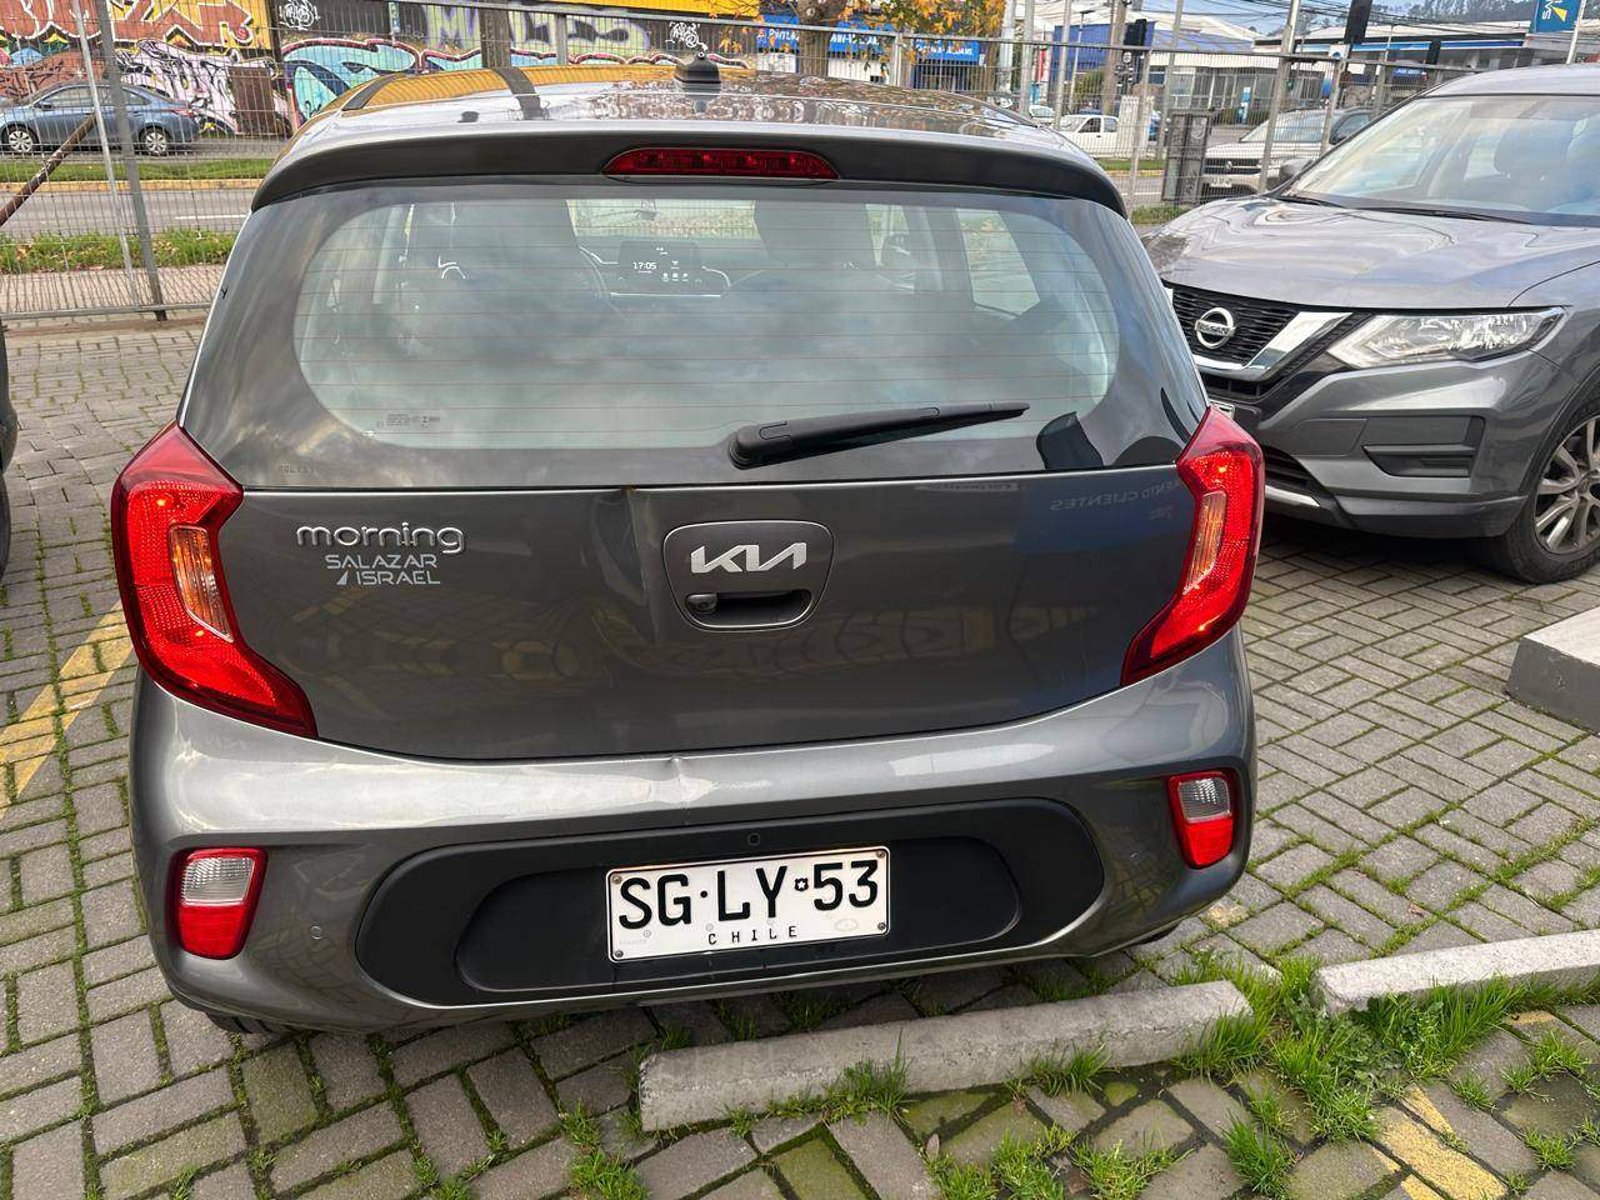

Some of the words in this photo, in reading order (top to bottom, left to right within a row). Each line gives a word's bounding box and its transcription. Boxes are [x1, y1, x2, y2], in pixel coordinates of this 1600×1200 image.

[633, 261, 657, 270] 17:05
[296, 521, 465, 553] morning
[324, 554, 438, 569] SALAZAR
[690, 542, 807, 573] KIA
[355, 570, 441, 585] ISRAEL
[708, 926, 798, 945] CHILE
